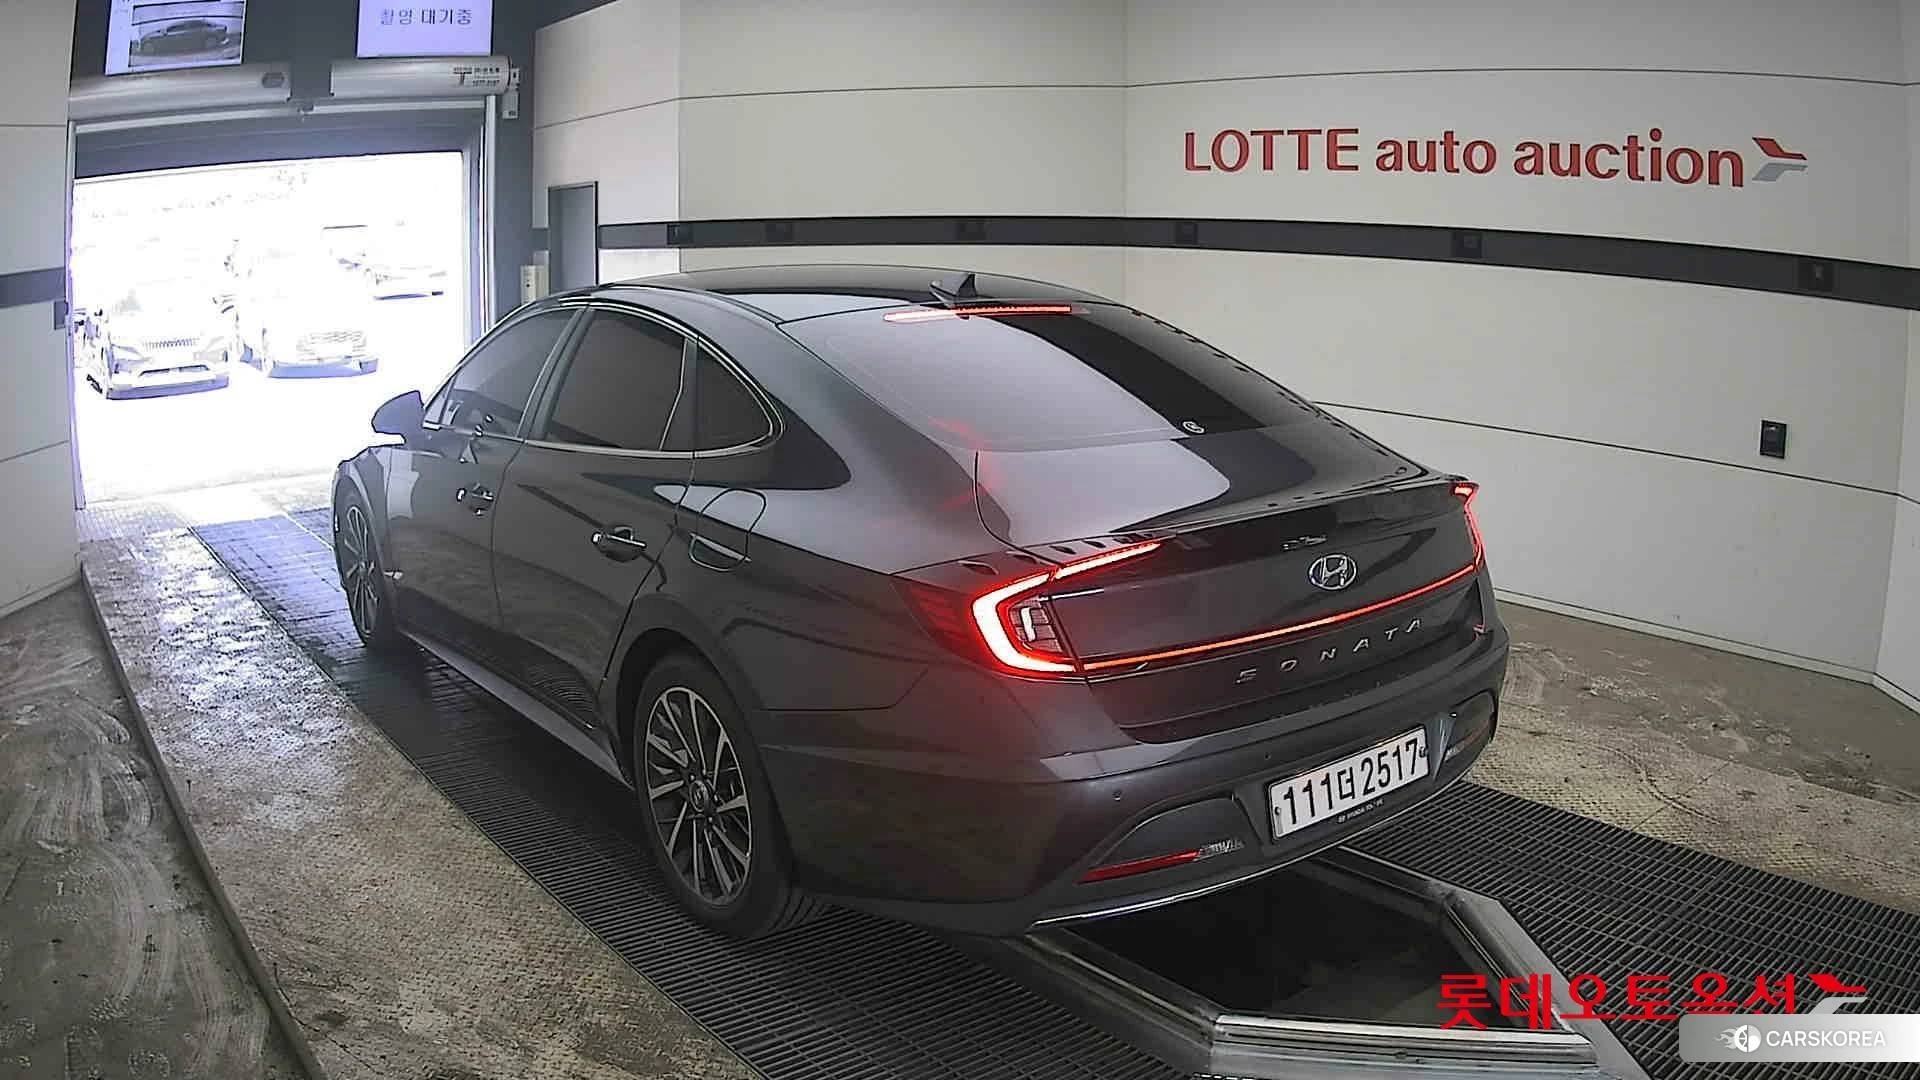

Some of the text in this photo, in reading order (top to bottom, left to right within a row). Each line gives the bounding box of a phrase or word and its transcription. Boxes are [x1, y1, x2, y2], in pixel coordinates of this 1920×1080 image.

[421, 8, 472, 25] 대기중
[1185, 127, 1744, 188] LOTTE auto auction
[1234, 618, 1422, 684] SONATA
